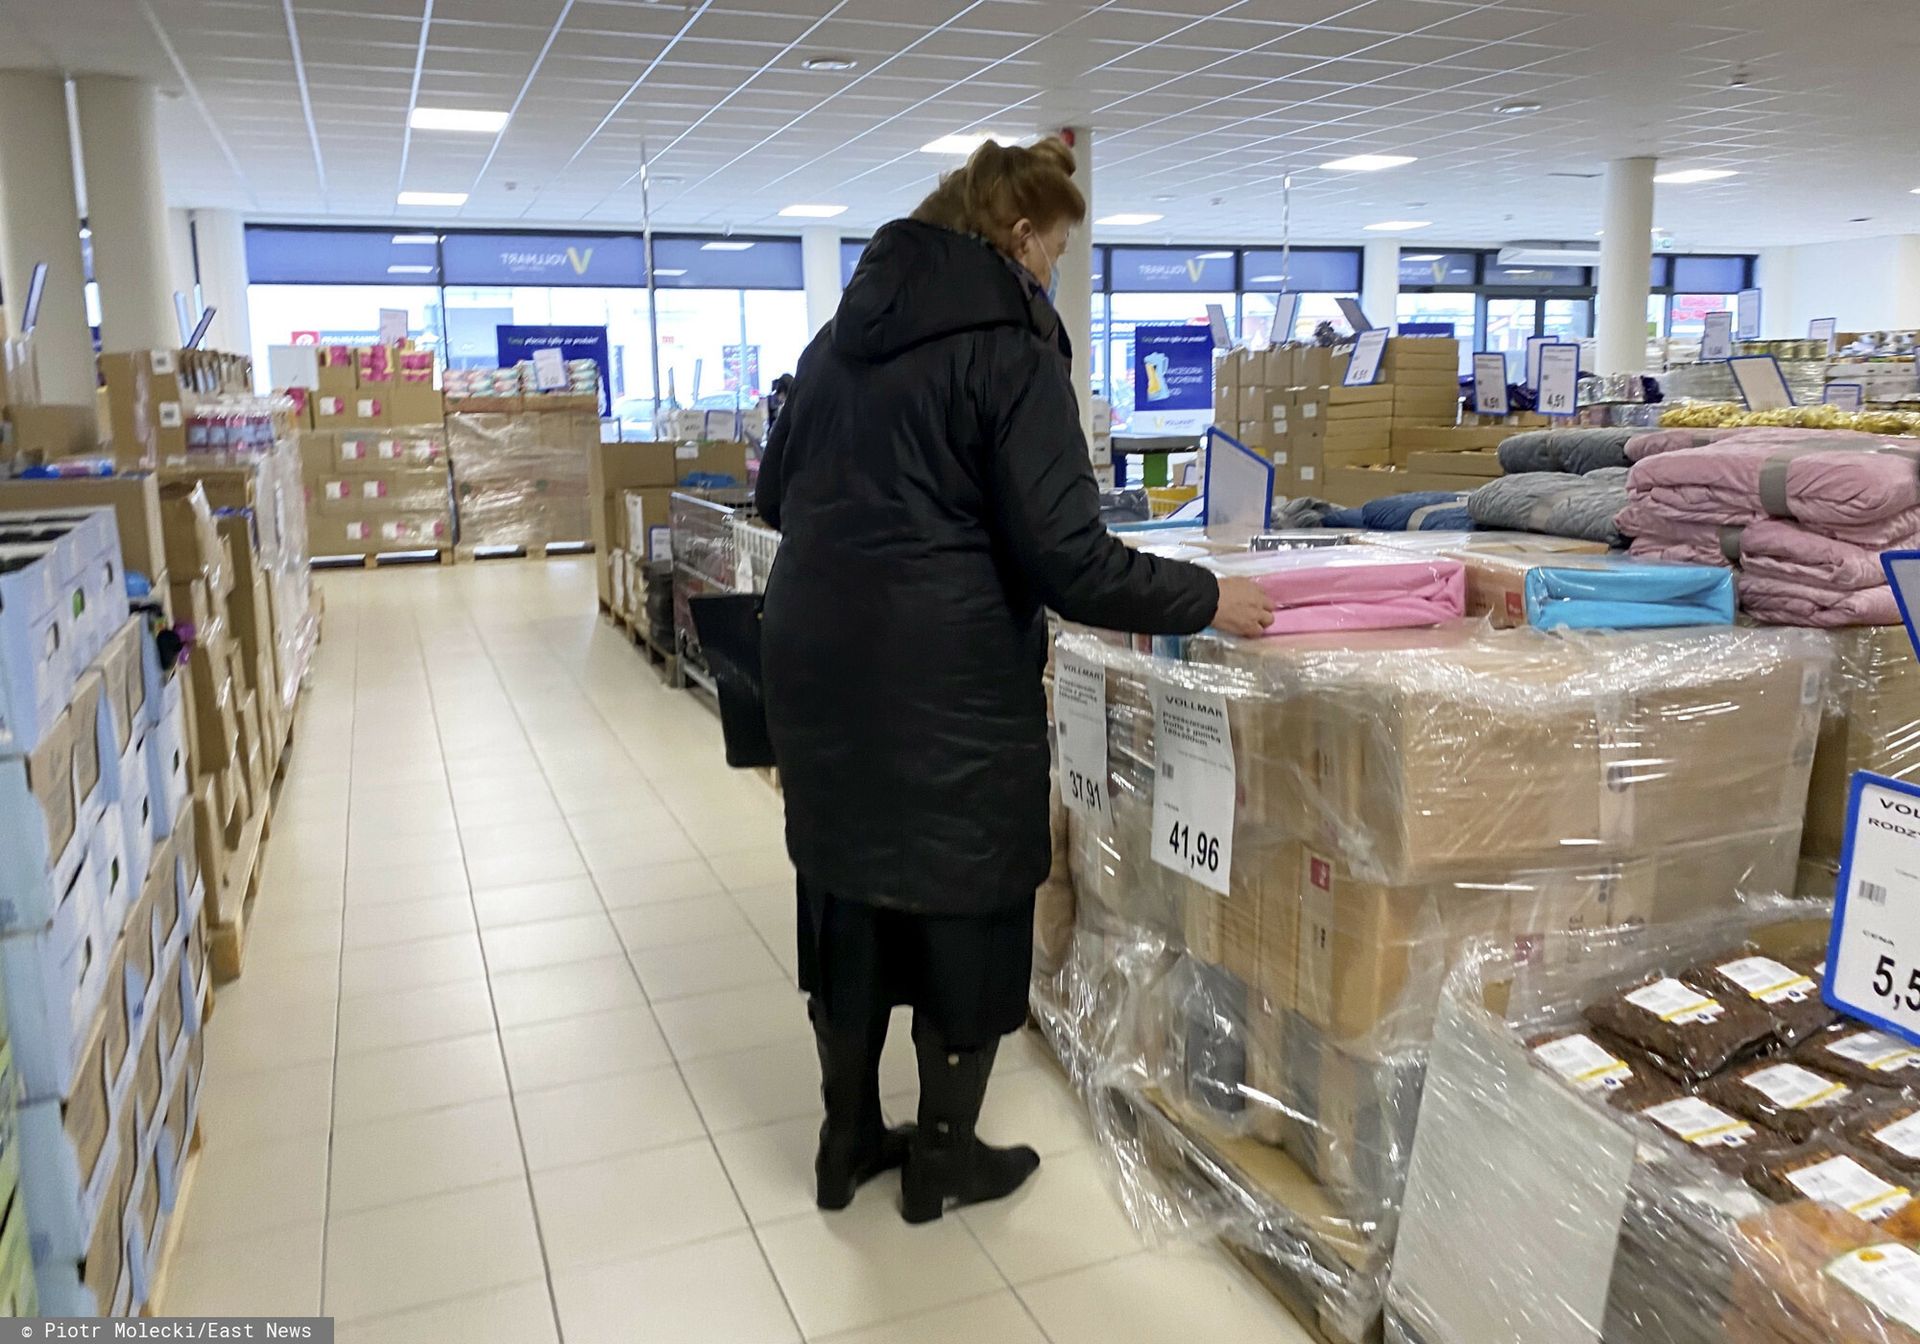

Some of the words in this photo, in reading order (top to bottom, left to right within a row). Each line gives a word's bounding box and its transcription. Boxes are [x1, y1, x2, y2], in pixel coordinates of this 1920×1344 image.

[1069, 769, 1102, 812] 37,91
[1168, 820, 1220, 873] 41,96
[1862, 929, 1895, 947] CENA
